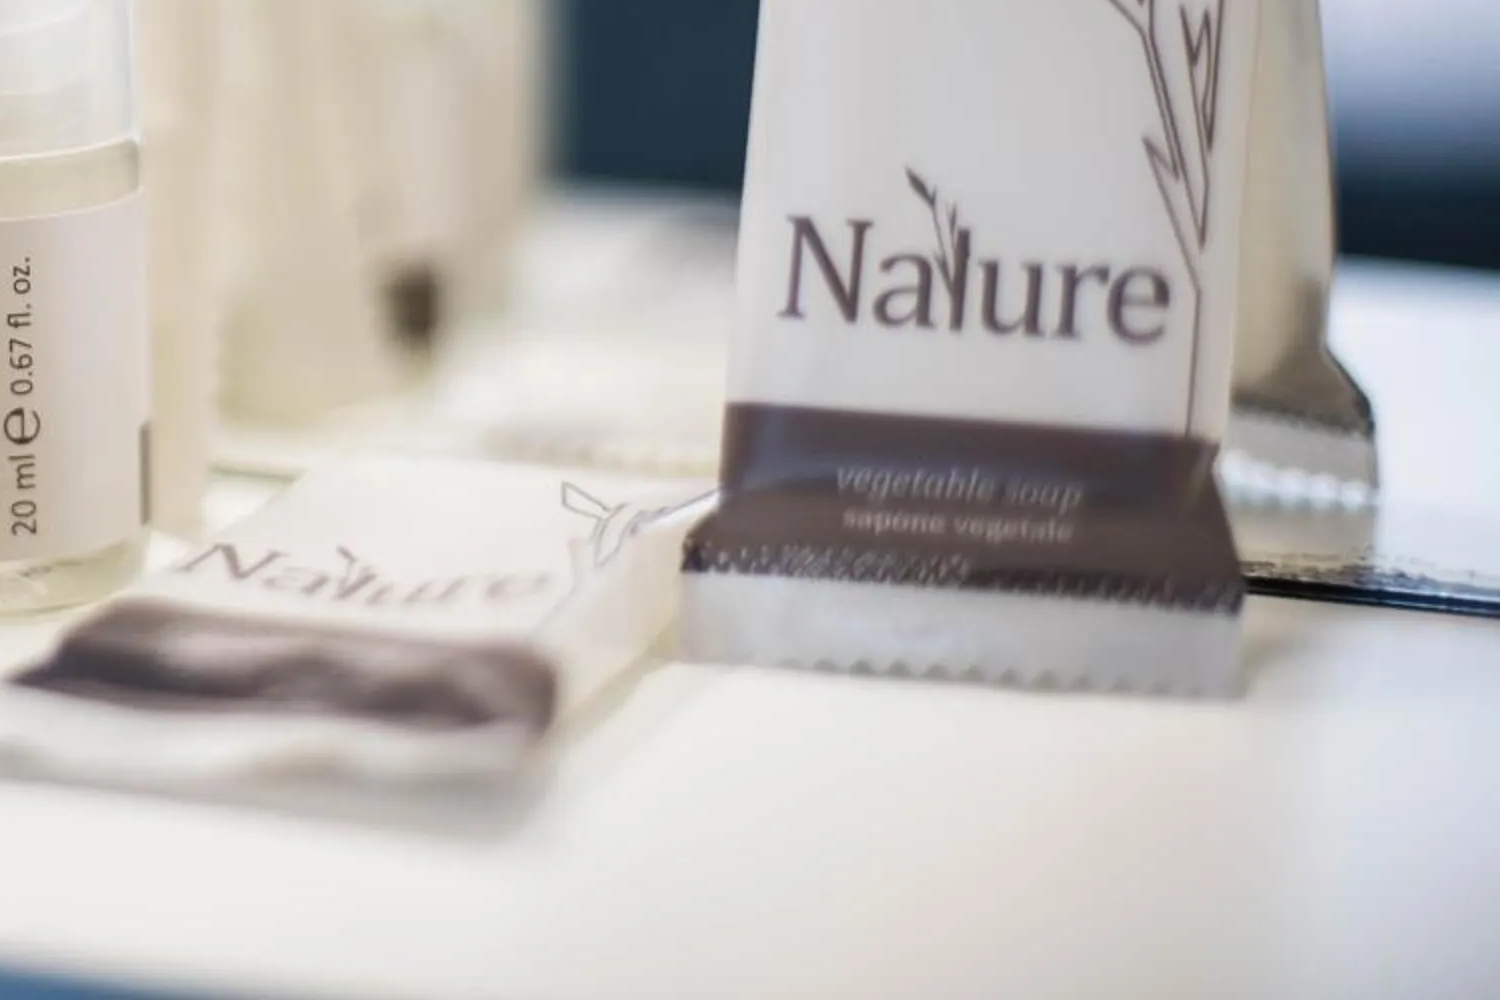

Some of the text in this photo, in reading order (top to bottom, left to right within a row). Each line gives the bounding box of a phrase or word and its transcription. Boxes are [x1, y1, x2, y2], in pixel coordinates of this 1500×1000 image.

[12, 256, 32, 295] oz.
[777, 166, 1172, 347] Nature
[6, 302, 32, 329] fl.
[8, 338, 34, 396] 0.67
[7, 453, 37, 490] ml
[836, 465, 997, 504] vegetable
[10, 500, 37, 537] 20
[842, 507, 947, 537] sapone
[175, 543, 554, 606] Nature
